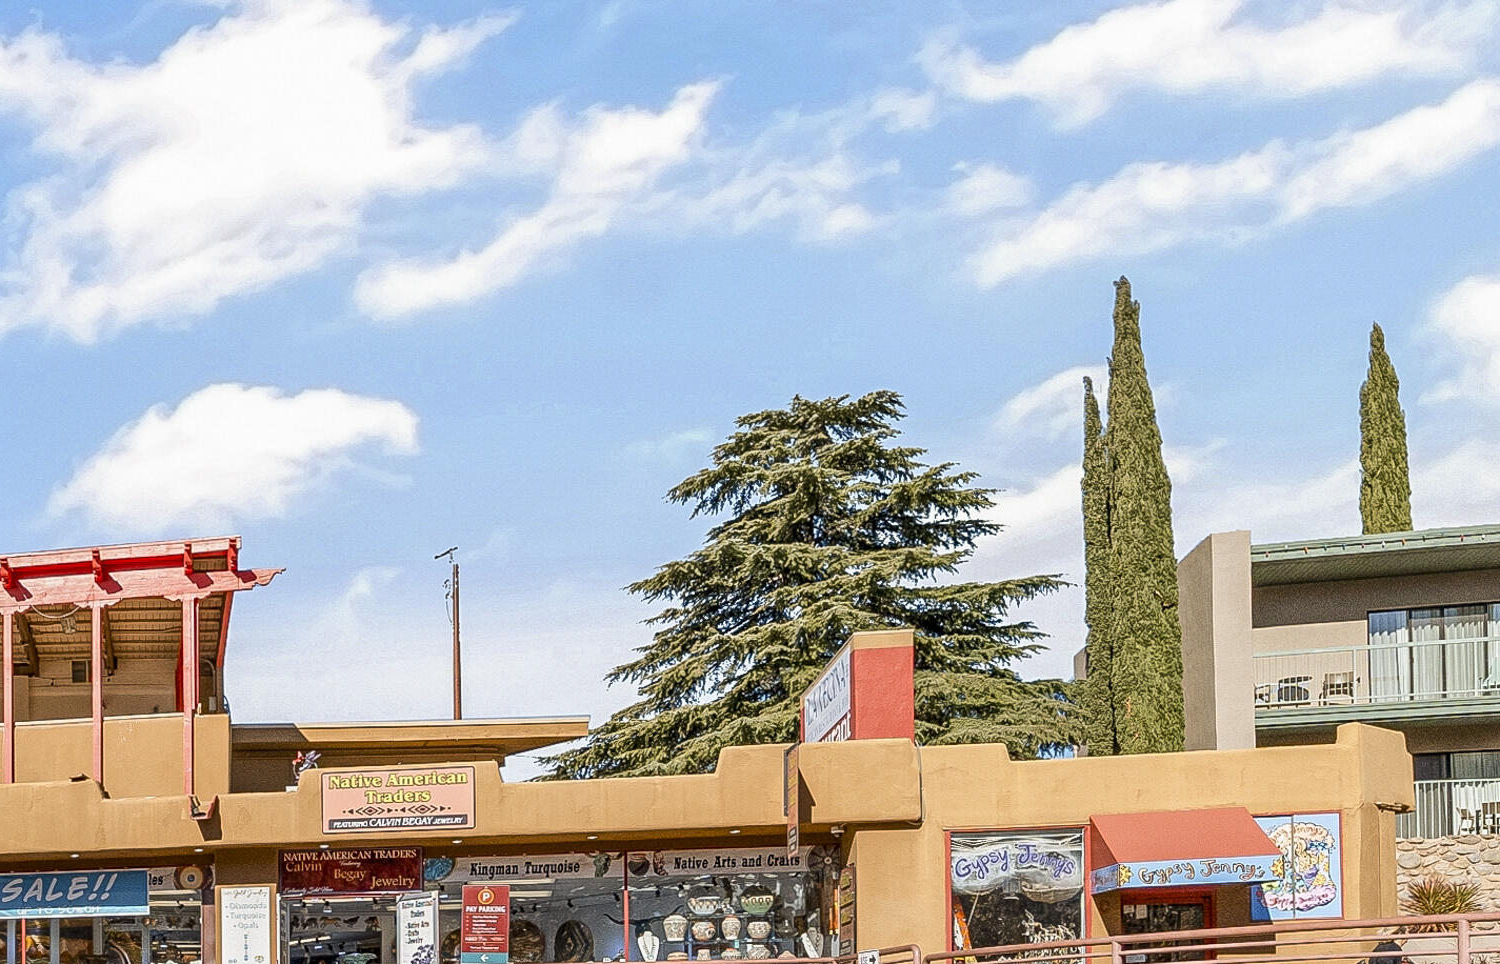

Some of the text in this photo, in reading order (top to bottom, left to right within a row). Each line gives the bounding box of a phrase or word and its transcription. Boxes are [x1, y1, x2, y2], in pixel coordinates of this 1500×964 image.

[329, 771, 468, 789] Native American
[365, 789, 431, 804] Traders
[333, 816, 464, 829] FEATURING CALVIN BEGAY JEWELRY
[283, 849, 417, 862] NATIVE AMERICAN TRADERS
[673, 853, 800, 870] Native Arts and Crafts
[285, 861, 322, 873] Calvin
[469, 860, 581, 880] Kingman Turquoise
[955, 849, 1008, 880] Gypsy
[1138, 861, 1195, 884] Gypsy
[1200, 859, 1266, 881] Jenny's
[149, 873, 164, 886] les
[334, 868, 367, 881] Begay
[1, 873, 118, 902] SALE!!
[370, 875, 415, 889] Jewelry
[482, 892, 491, 902] P
[479, 905, 506, 913] PARKING
